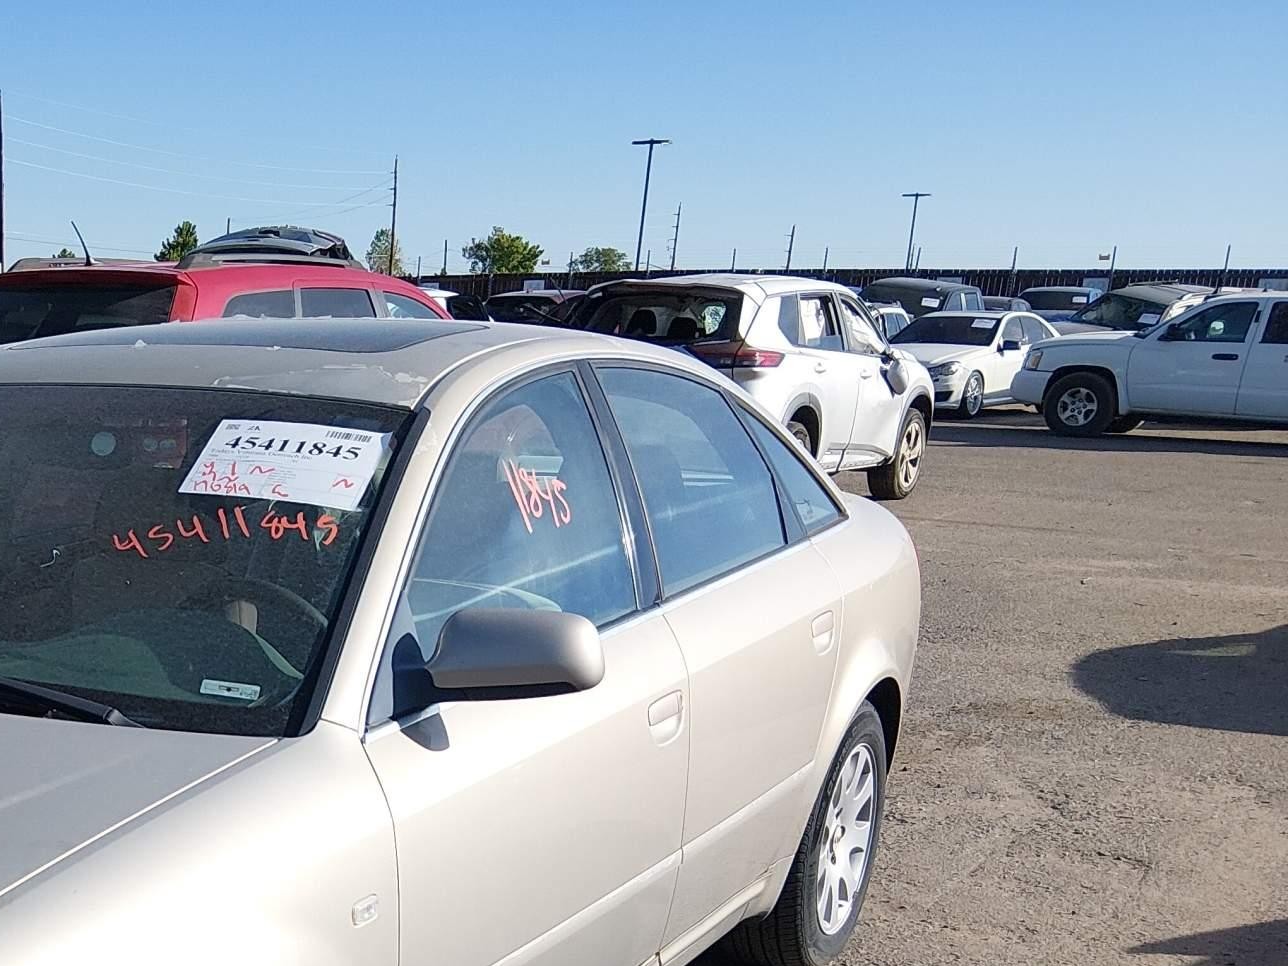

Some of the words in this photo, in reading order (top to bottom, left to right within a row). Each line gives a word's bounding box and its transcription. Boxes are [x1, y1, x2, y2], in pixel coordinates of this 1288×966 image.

[224, 435, 362, 461] 45411845
[502, 457, 571, 534] 11845
[112, 506, 339, 557] 45411845
